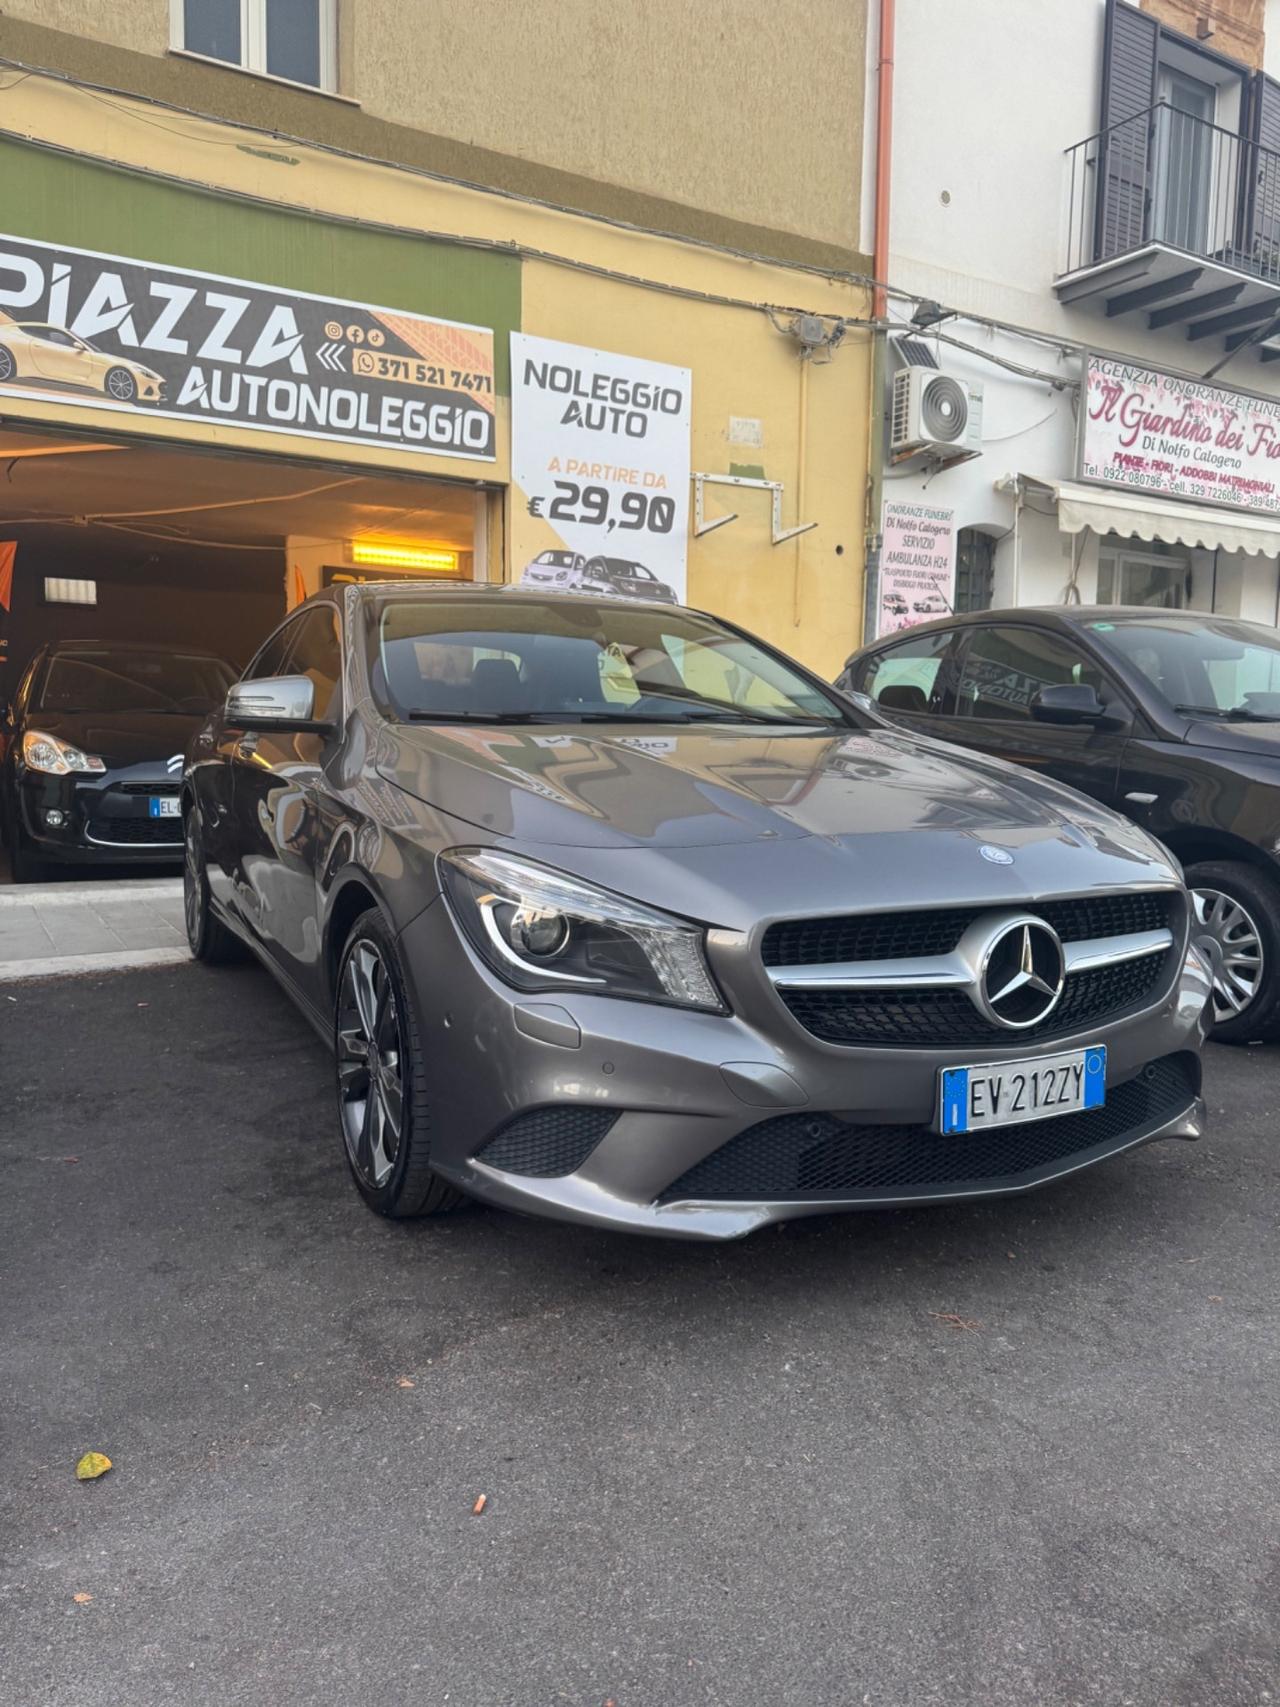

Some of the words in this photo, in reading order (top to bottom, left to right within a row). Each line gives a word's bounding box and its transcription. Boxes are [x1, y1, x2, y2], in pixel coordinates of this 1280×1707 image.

[378, 357, 410, 380] 371
[416, 364, 446, 385] 521
[450, 370, 492, 394] 7471
[523, 358, 683, 416] NOLEGGIO
[1089, 359, 1159, 388] AGENZIA
[1163, 377, 1243, 409] ONORANZE
[177, 366, 490, 450] AUTONOLEGGIO
[560, 399, 648, 439] AUTO
[1119, 392, 1213, 448] Giardino
[1214, 407, 1244, 451] dei
[1142, 435, 1156, 452] Di
[1158, 439, 1191, 460] Nolfo
[1193, 446, 1243, 470] Calogero
[547, 456, 561, 473] A
[566, 458, 640, 486] PARTIRE
[642, 471, 668, 490] DA
[1083, 462, 1101, 477] Tel.
[1103, 466, 1127, 482] 0922
[1190, 483, 1206, 497] 329
[1179, 465, 1218, 483] ADDOBBI
[549, 480, 676, 534] 29,90
[887, 551, 931, 567] AMBULANZA
